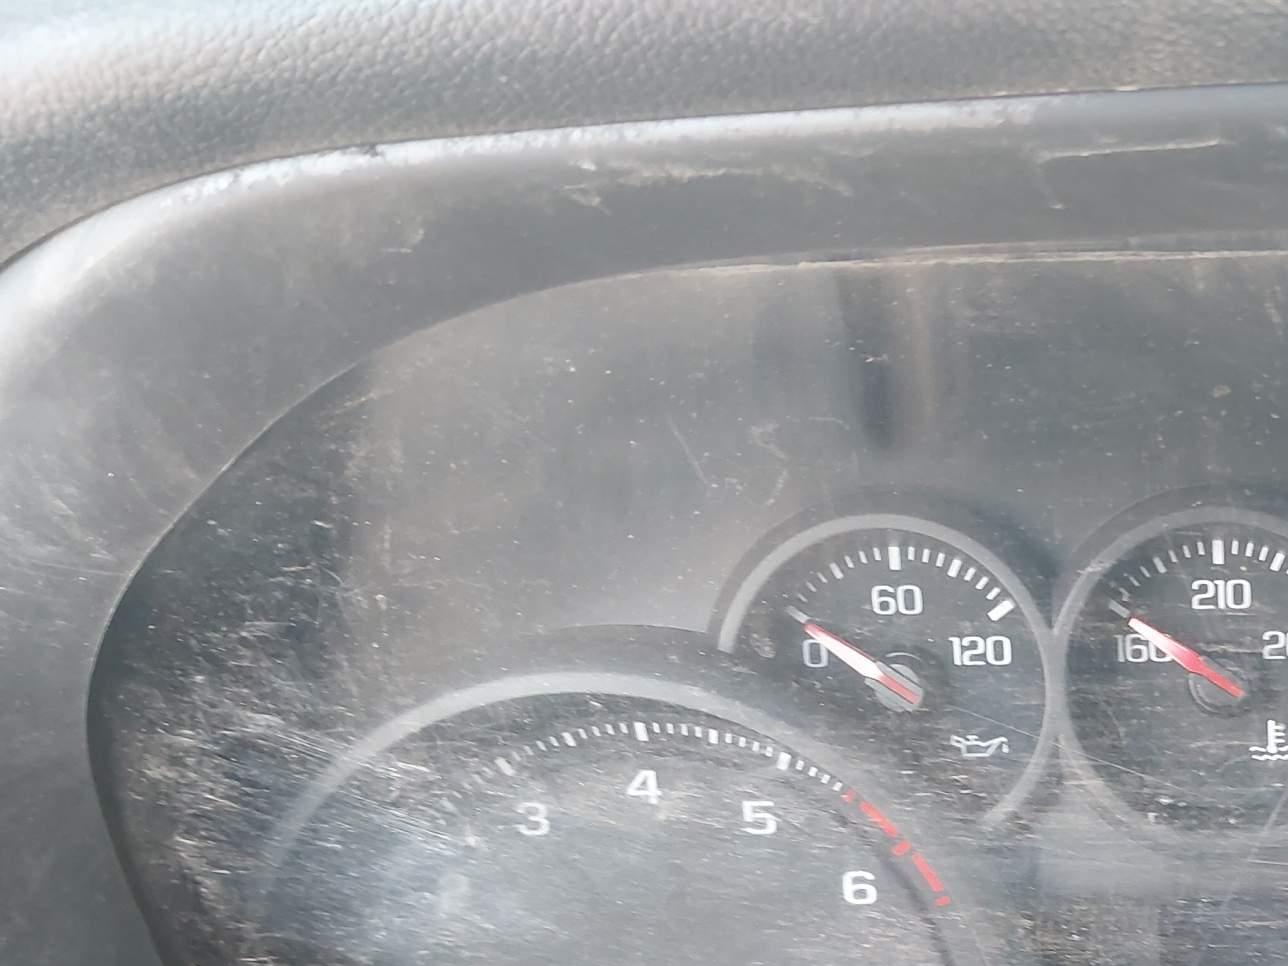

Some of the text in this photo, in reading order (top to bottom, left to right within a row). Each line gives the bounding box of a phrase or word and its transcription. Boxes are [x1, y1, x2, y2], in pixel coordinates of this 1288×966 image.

[871, 584, 923, 615] 60
[1191, 579, 1251, 610] 210
[802, 639, 829, 668] 0
[950, 635, 1012, 667] 120
[1114, 633, 1174, 663] 160
[626, 769, 662, 805] 4
[516, 803, 551, 837] 3
[741, 800, 778, 836] 5
[842, 871, 878, 906] 6
